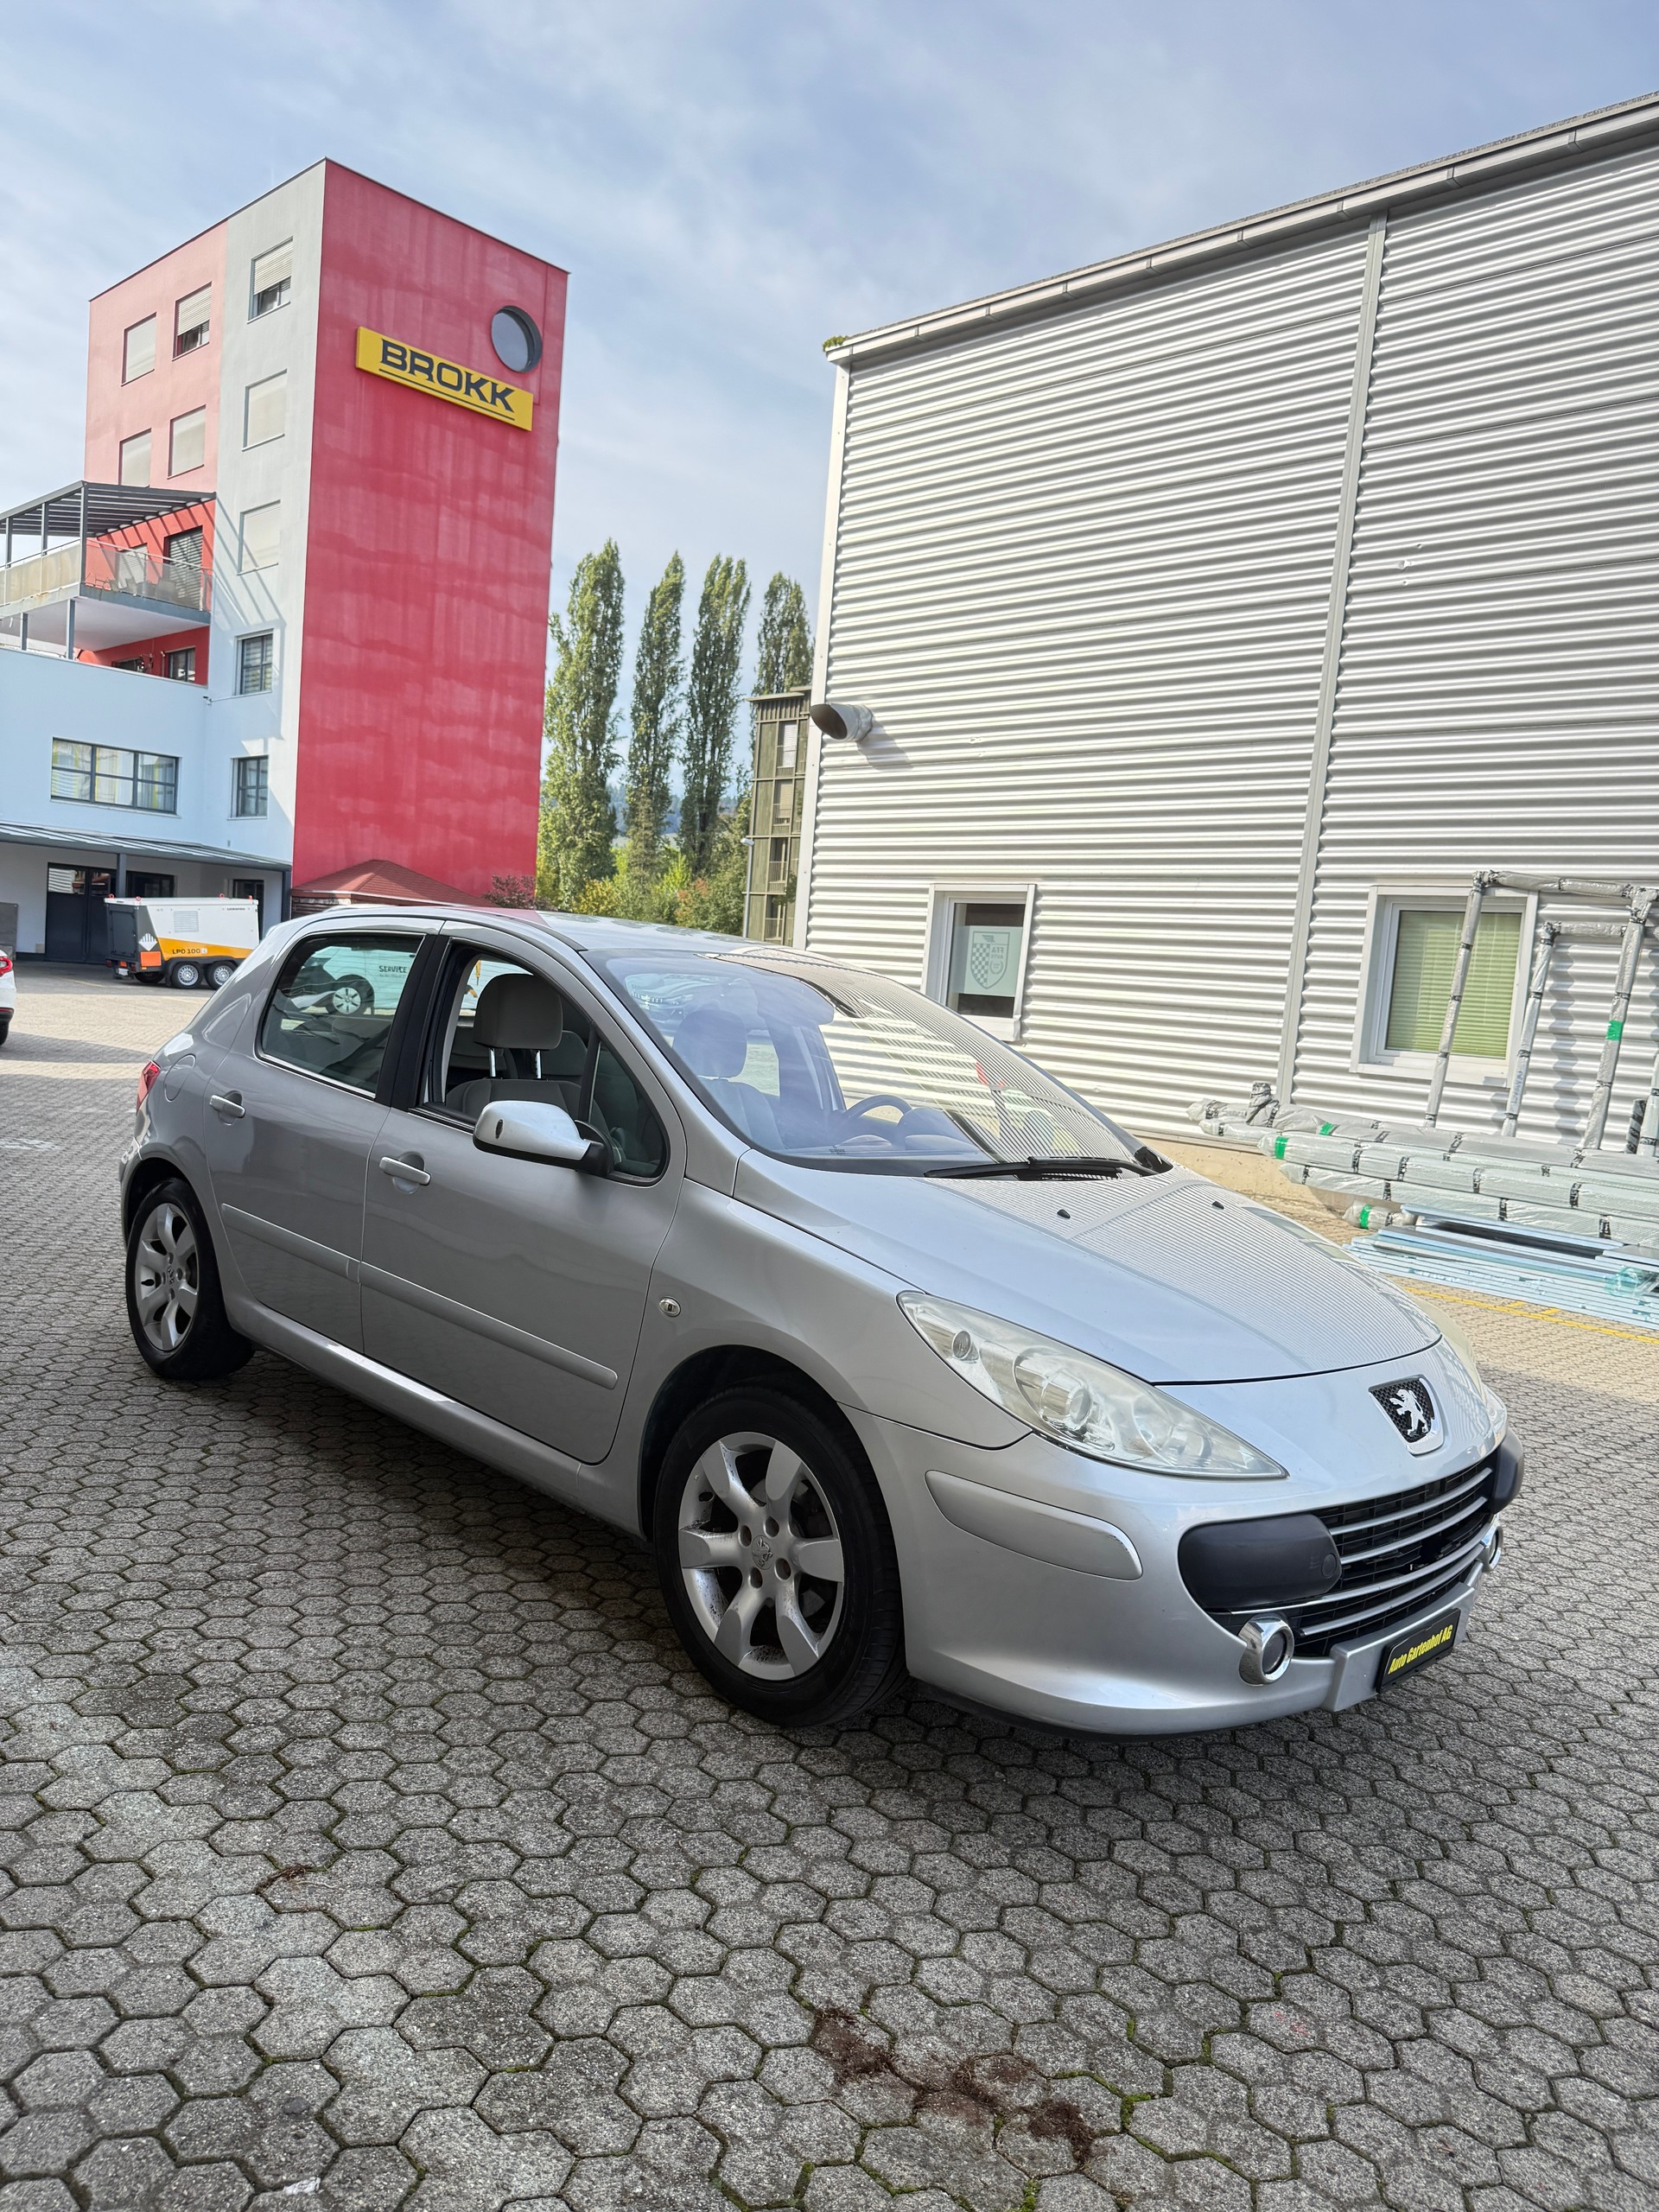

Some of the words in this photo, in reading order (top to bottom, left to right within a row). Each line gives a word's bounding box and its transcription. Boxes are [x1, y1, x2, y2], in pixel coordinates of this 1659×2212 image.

[380, 338, 515, 414] BROKK
[378, 965, 407, 974] SERVICE
[1388, 1653, 1407, 1675] Auto
[1407, 1630, 1443, 1663] Gartenhof
[1441, 1624, 1453, 1643] AG
